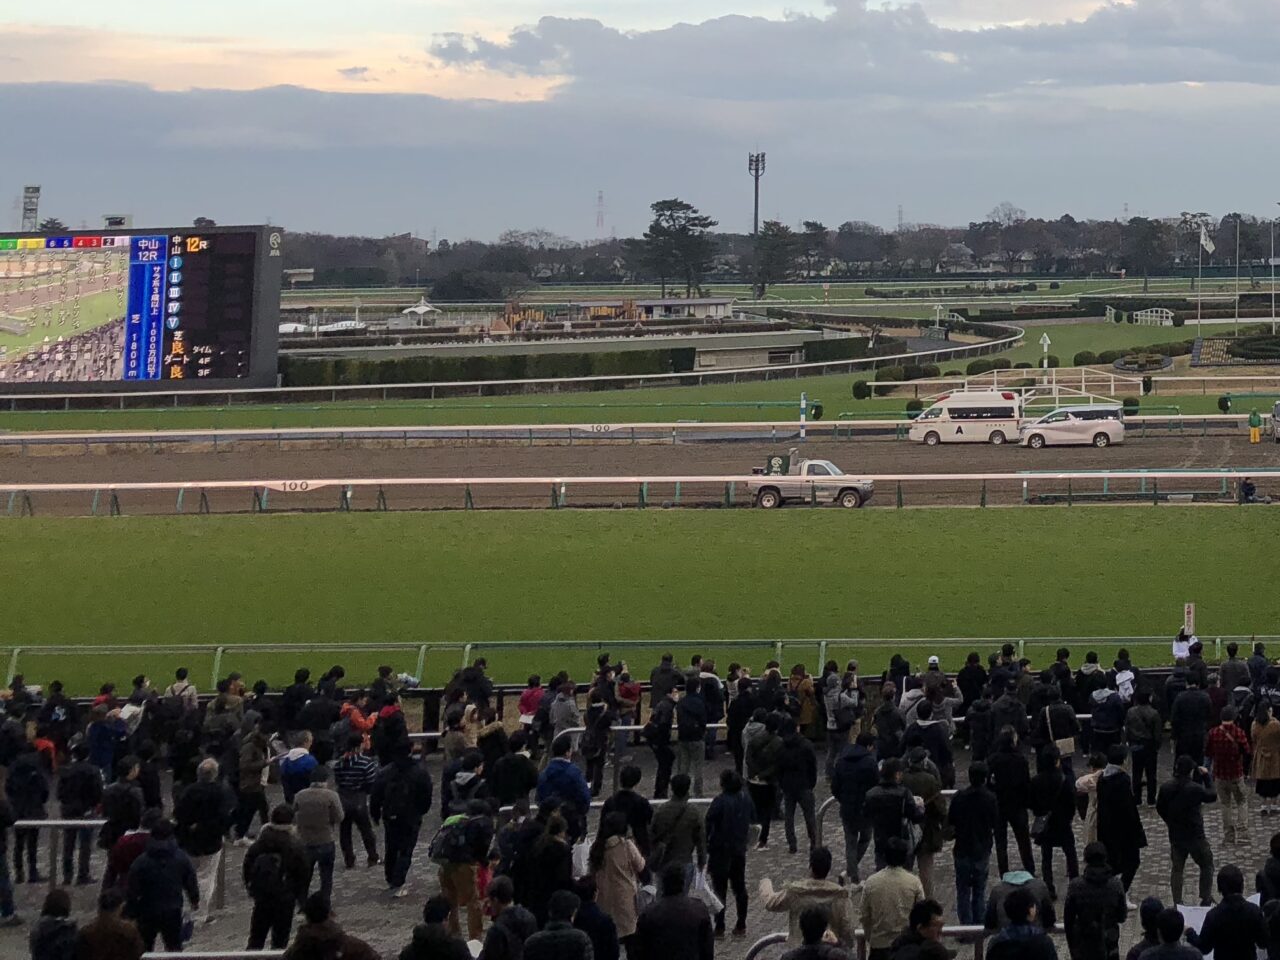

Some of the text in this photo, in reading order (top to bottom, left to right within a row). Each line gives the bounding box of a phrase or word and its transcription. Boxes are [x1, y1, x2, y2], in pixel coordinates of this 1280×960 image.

[138, 239, 159, 249] 中山
[172, 235, 181, 255] 中山
[186, 237, 208, 252] 12R
[138, 251, 157, 261] 12R
[172, 341, 184, 354] 良
[192, 345, 212, 353] タイム
[164, 355, 190, 365] ダート
[170, 365, 184, 379] 良
[590, 424, 610, 432] 100
[955, 425, 964, 435] A
[281, 481, 309, 491] 100
